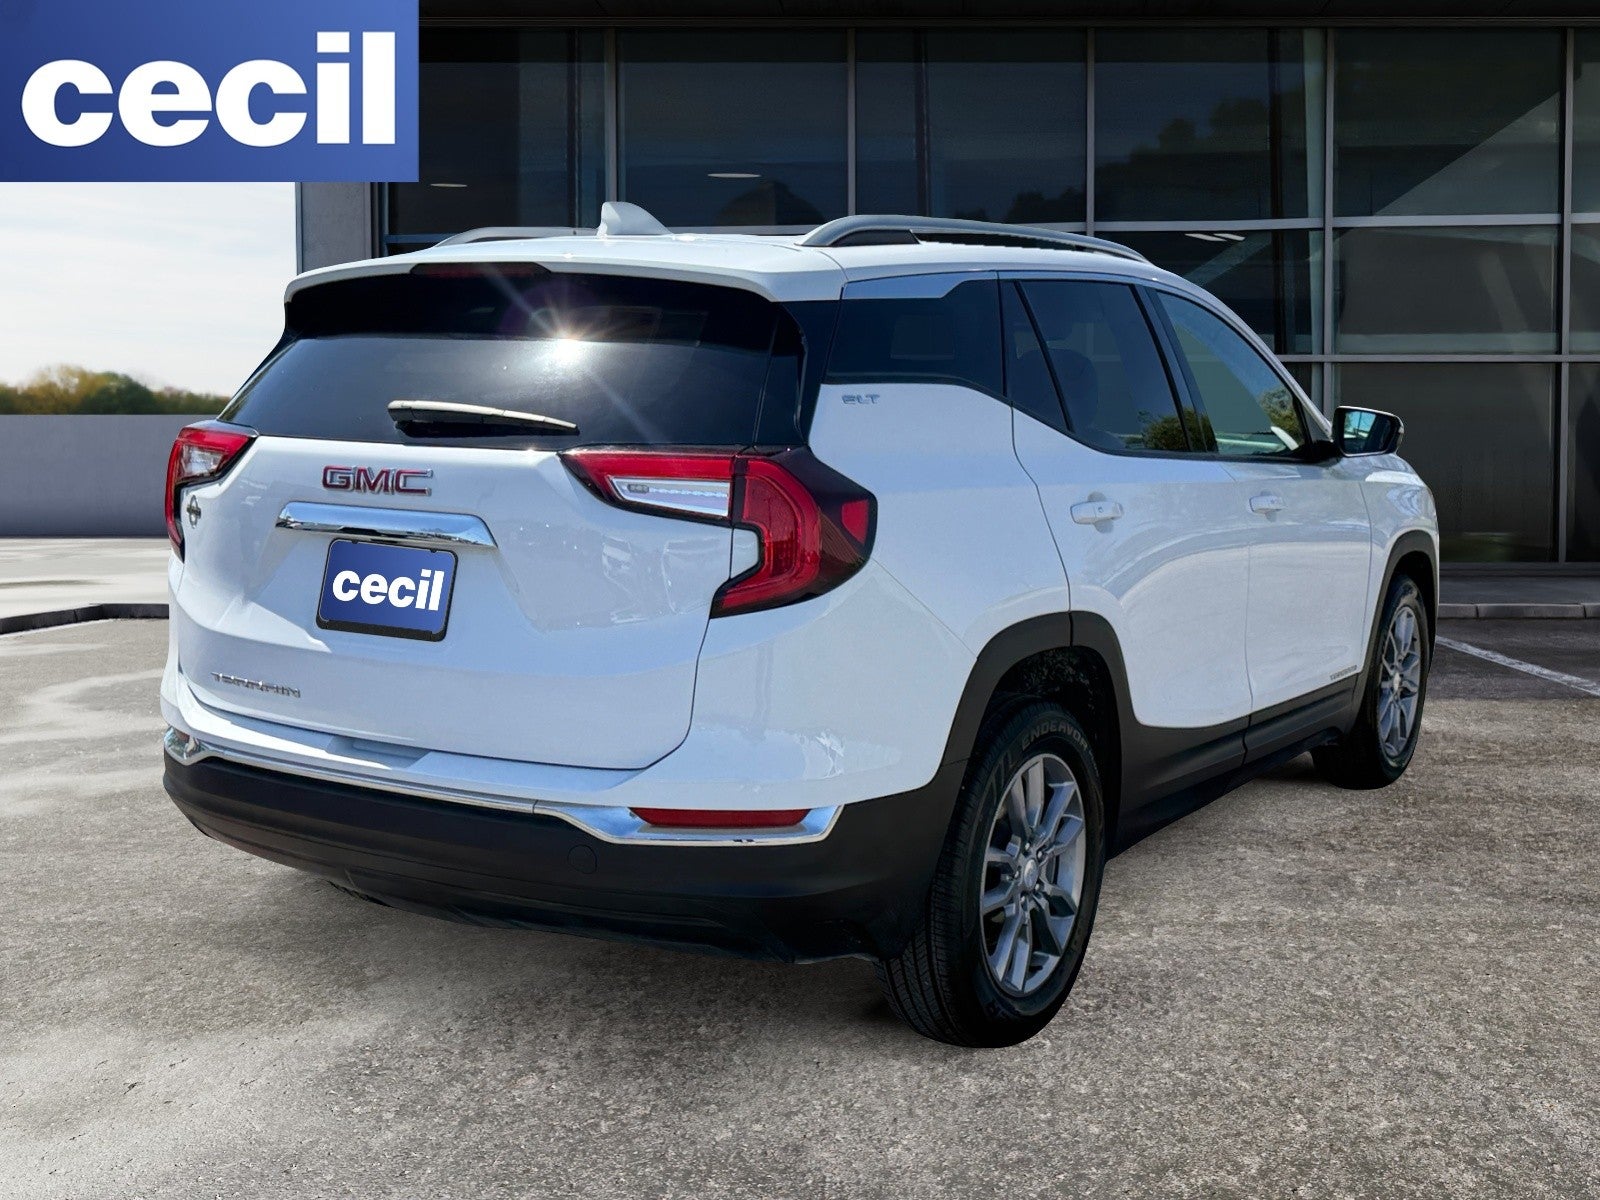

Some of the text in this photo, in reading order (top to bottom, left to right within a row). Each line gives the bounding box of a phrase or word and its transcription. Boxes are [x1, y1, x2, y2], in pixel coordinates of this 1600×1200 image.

[321, 465, 434, 497] GMC
[332, 568, 445, 611] cecil
[1021, 720, 1088, 752] ENDEAVOR
